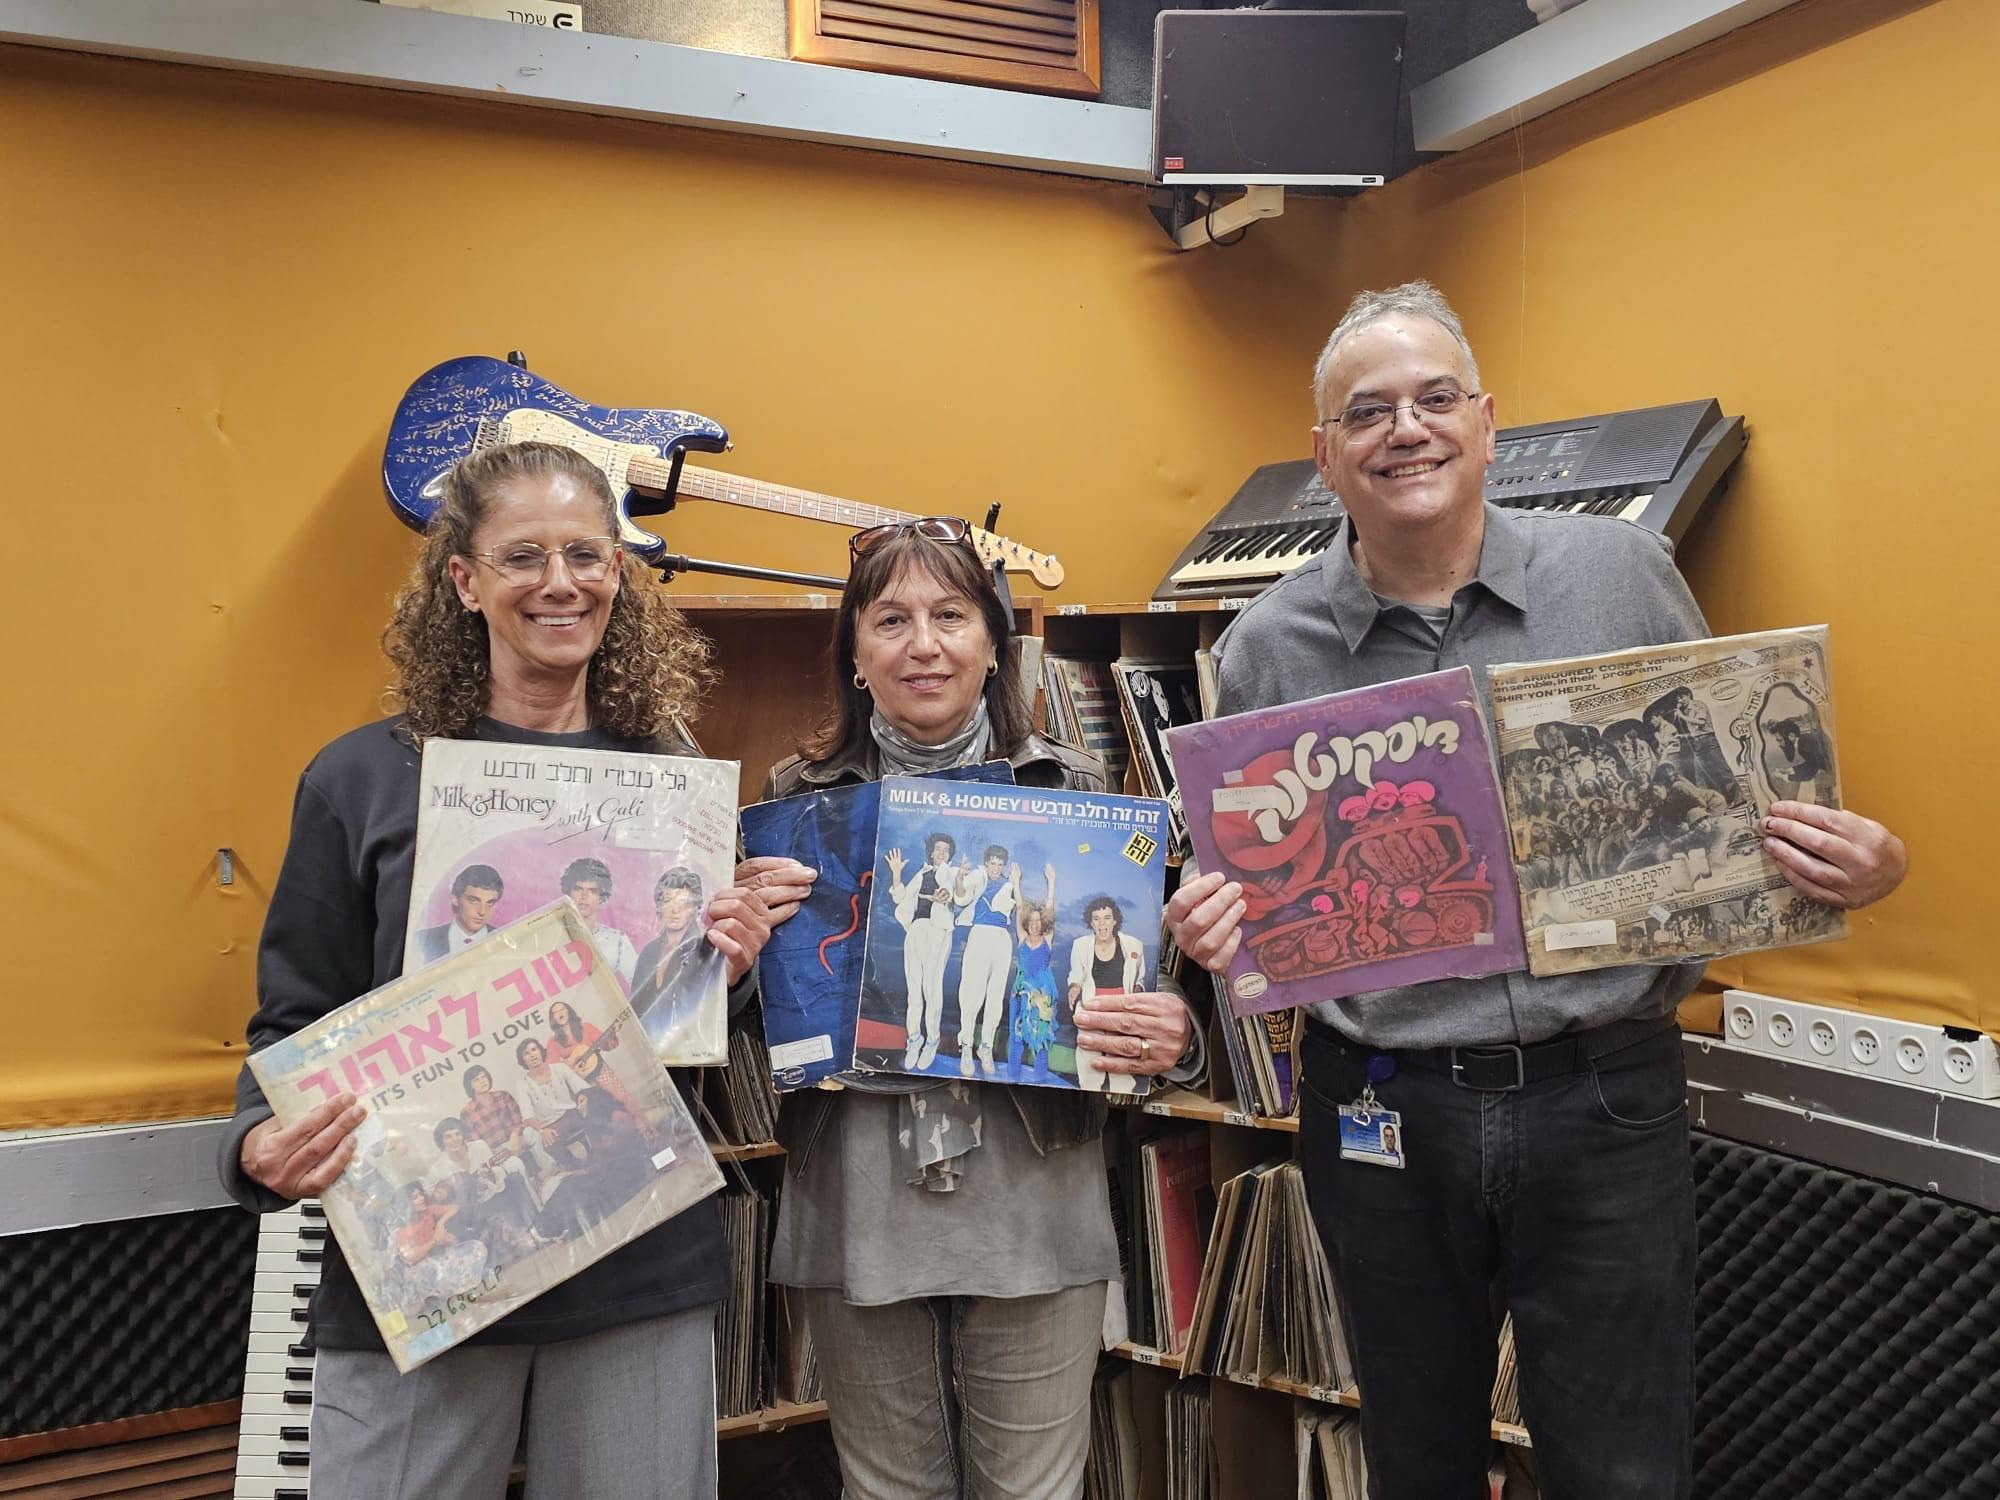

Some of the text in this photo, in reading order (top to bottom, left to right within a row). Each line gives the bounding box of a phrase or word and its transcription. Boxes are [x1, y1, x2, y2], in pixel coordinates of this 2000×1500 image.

[1523, 667, 1594, 682] ARMOURED
[1647, 655, 1690, 665] variety
[1570, 673, 1598, 684] their
[1602, 665, 1662, 680] program:
[483, 759, 687, 791] גלי עטרי וחלב ודבש
[889, 789, 1021, 812] MILK & HONEY
[1031, 800, 1160, 825] זהו זה חלב ודבש
[597, 797, 646, 838] Gali
[1561, 864, 1672, 902] להקת גייסות השריון
[1619, 880, 1659, 897] בתכנית
[492, 940, 594, 1018] טוב
[370, 1008, 545, 1111] IT'S FUN TO LOVE
